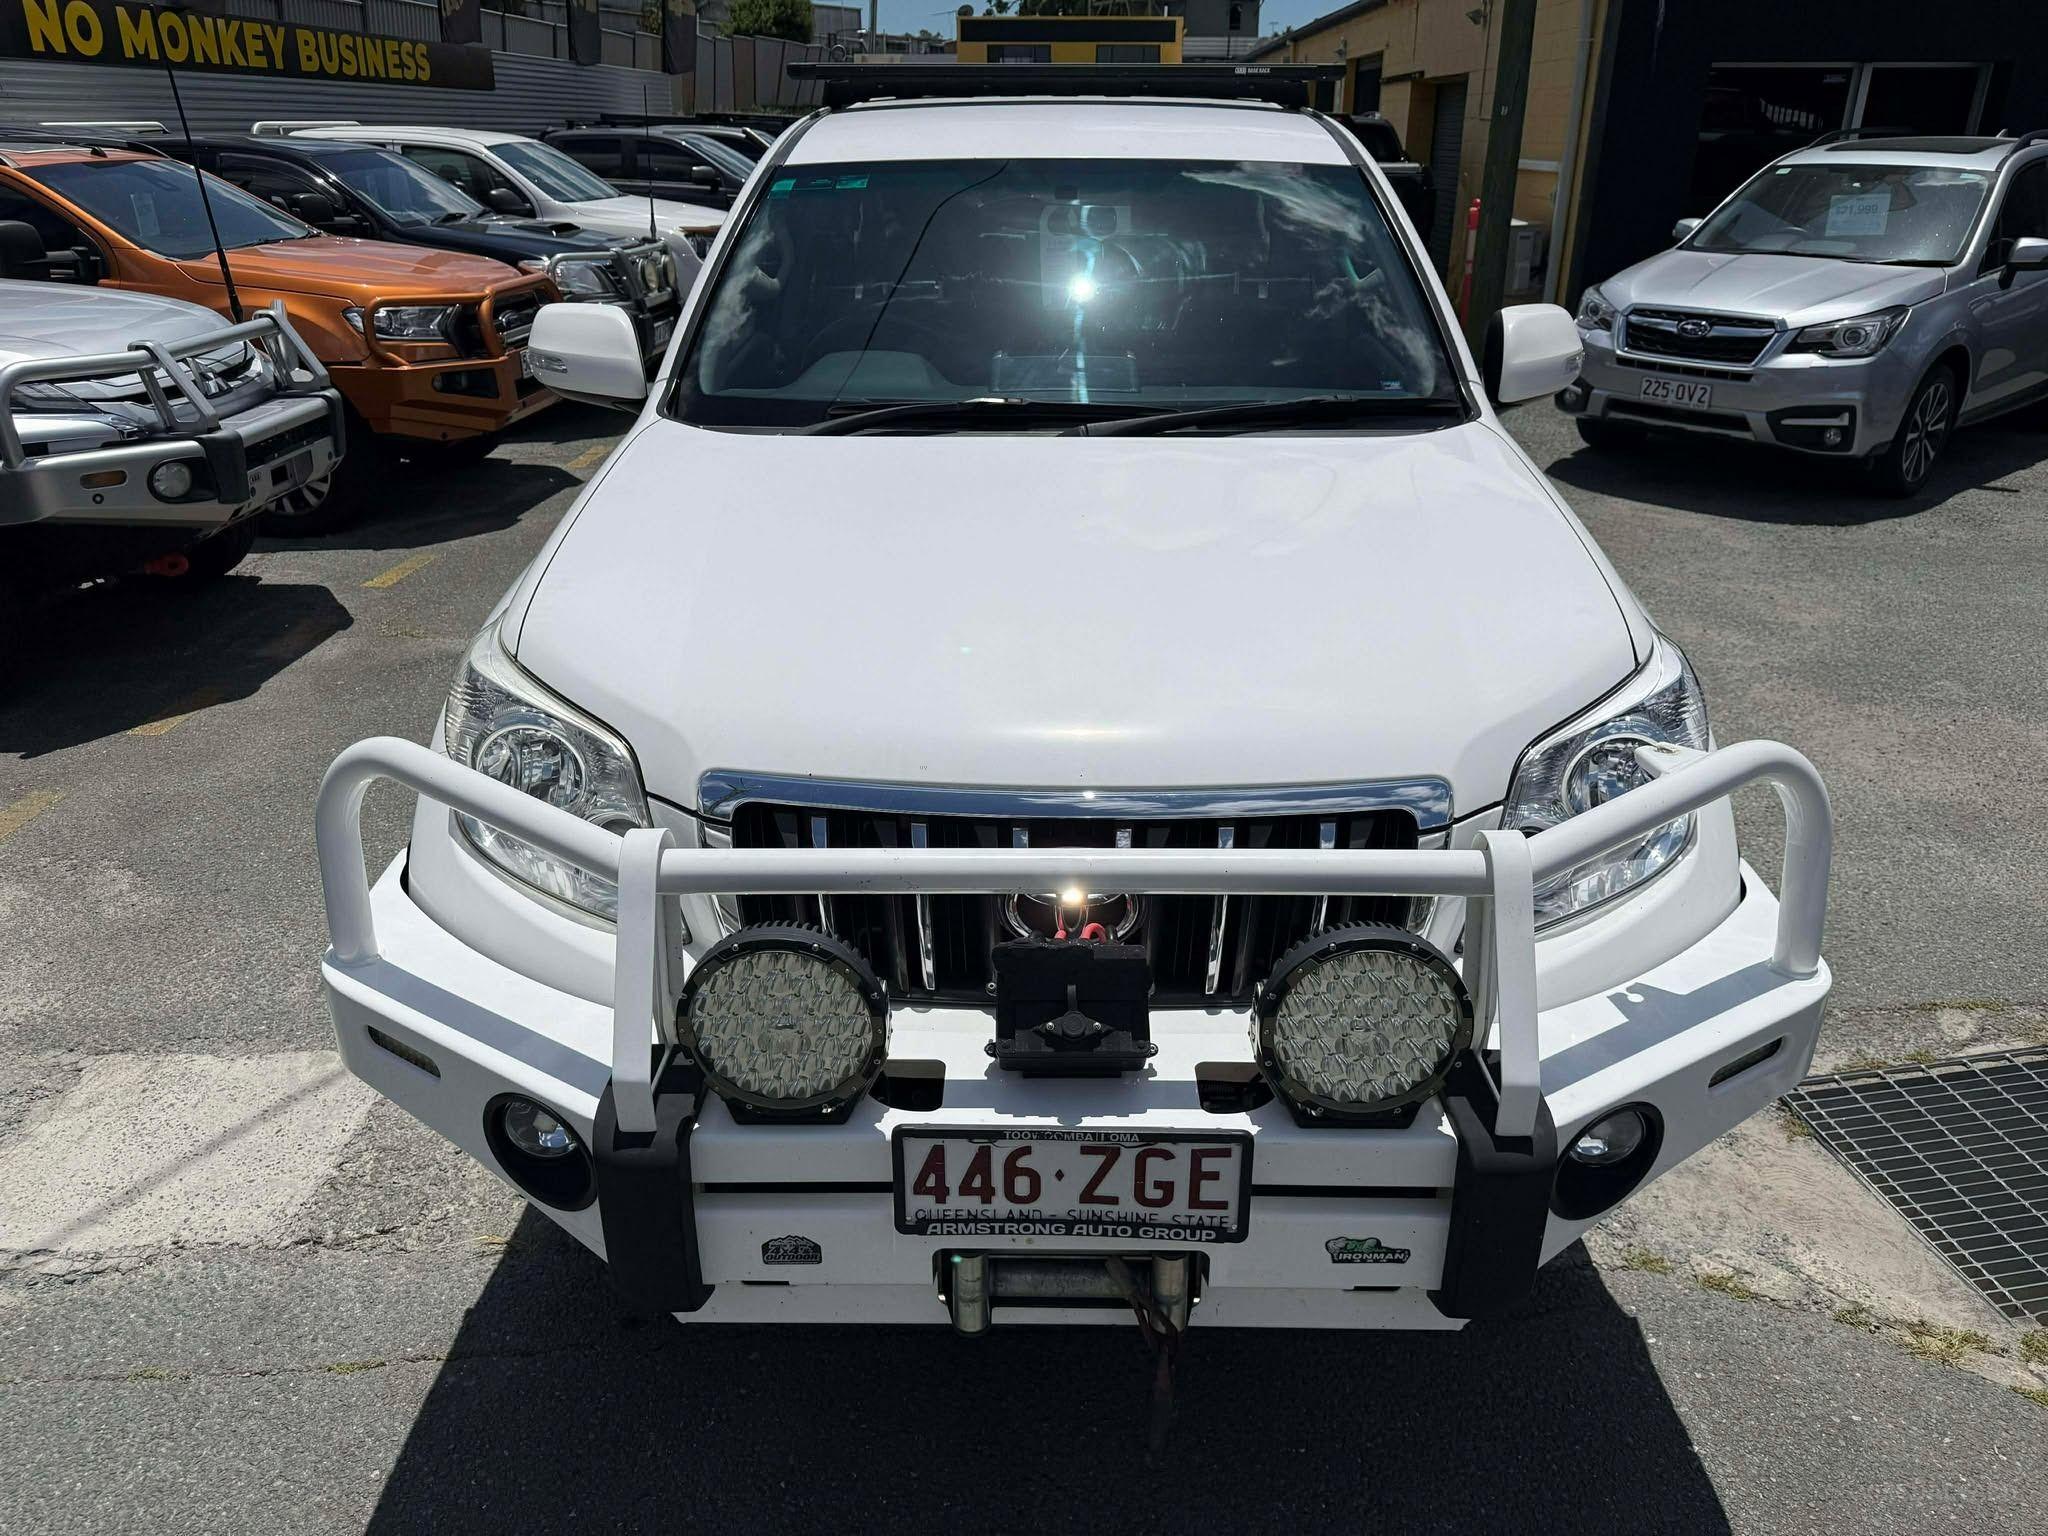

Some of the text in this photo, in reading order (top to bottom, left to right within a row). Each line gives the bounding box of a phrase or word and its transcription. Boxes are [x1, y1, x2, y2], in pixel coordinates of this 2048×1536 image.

[25, 0, 432, 81] NO MONKEY BUSINESS
[926, 1222, 1217, 1242] ARMSTRONG AUTO GROUP
[1338, 1252, 1405, 1260] IRONMAN
